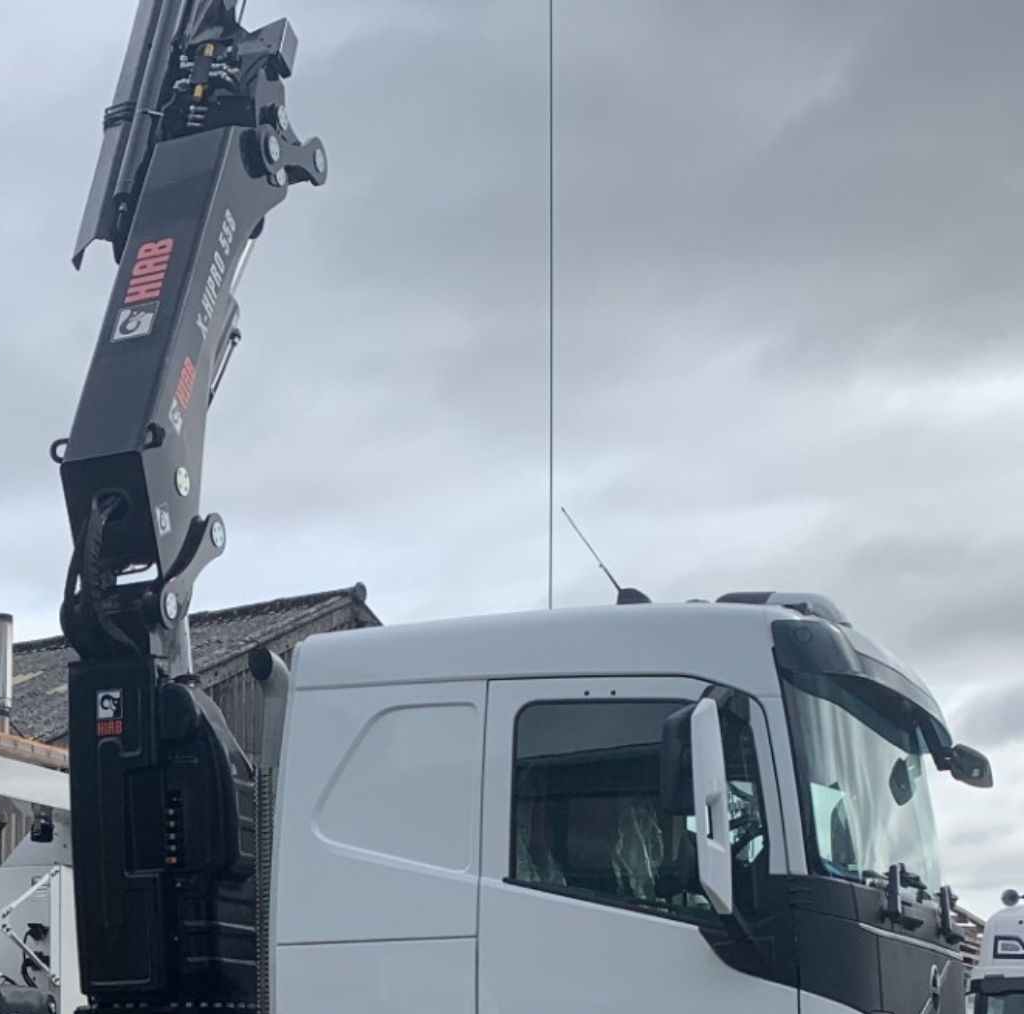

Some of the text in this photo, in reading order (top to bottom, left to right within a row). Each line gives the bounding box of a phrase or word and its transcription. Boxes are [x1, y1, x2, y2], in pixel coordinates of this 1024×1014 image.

[124, 237, 174, 304] HIAB
[196, 209, 237, 340] X-HIPRO 558
[175, 355, 197, 410] HIAB
